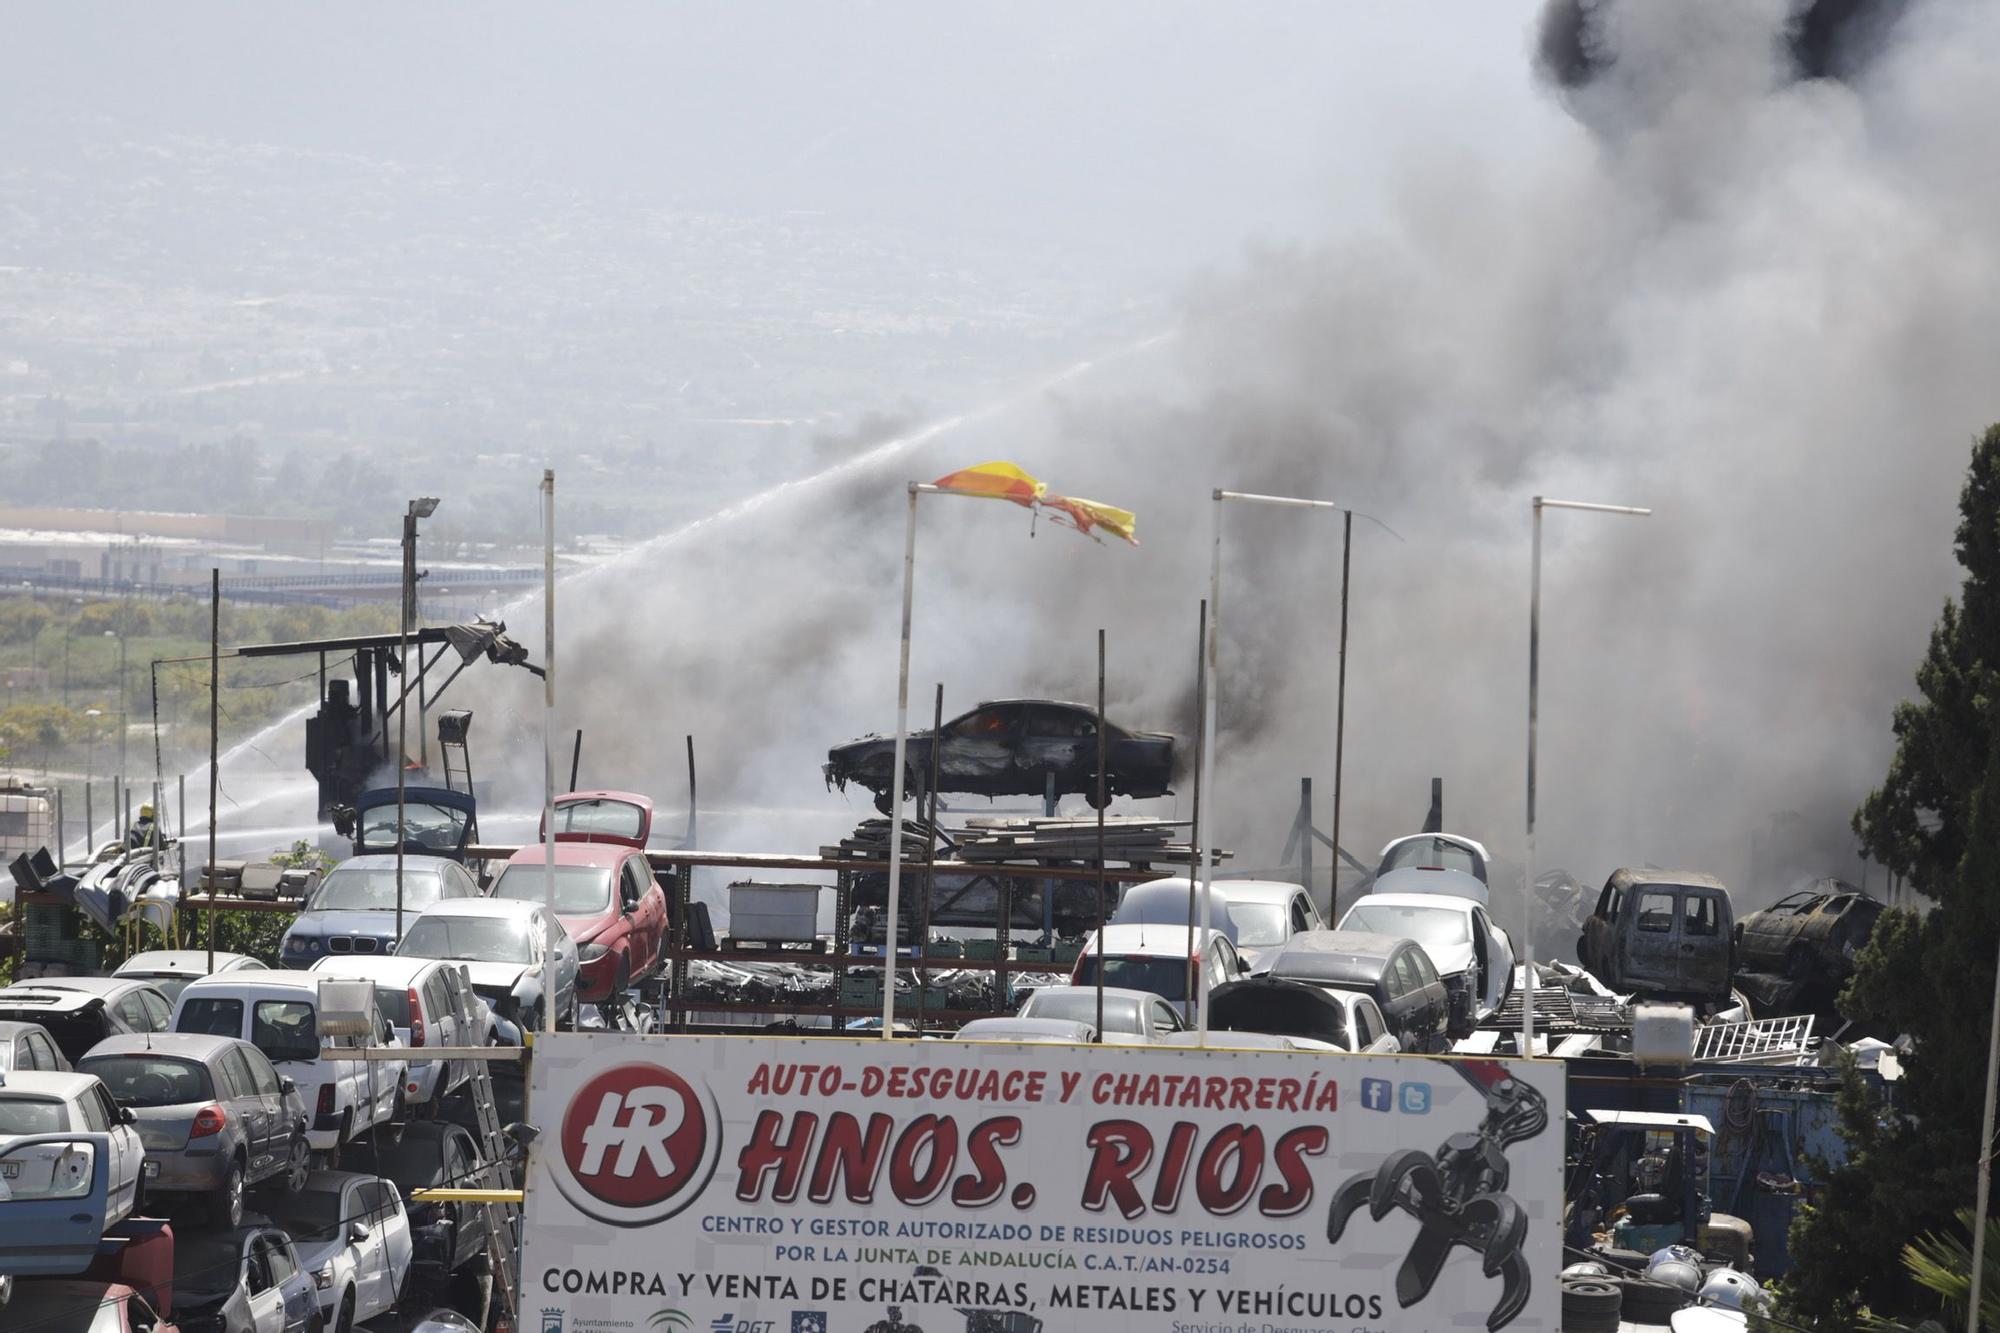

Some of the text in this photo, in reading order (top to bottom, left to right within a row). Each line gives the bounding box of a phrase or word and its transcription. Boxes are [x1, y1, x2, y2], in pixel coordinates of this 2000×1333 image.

[747, 1063, 1337, 1113] AUTO-DESGUACE Y CHATARRERÍA
[579, 1085, 685, 1179] HR
[736, 1109, 1329, 1219] HNOS. RIOS
[702, 1216, 1305, 1250] CENTRO Y GESTOR AUTORIZADO DE RESIDUOS PELIGROSOS
[776, 1246, 1230, 1274] POR LA JUNTA DE ANDALUCÍA C.A.T./AN-0254
[543, 1268, 1382, 1319] COMPRA Y VENTA DE CHATARRAS, METALES Y VEHÍCULOS
[573, 1318, 634, 1329] Ayuntamiento
